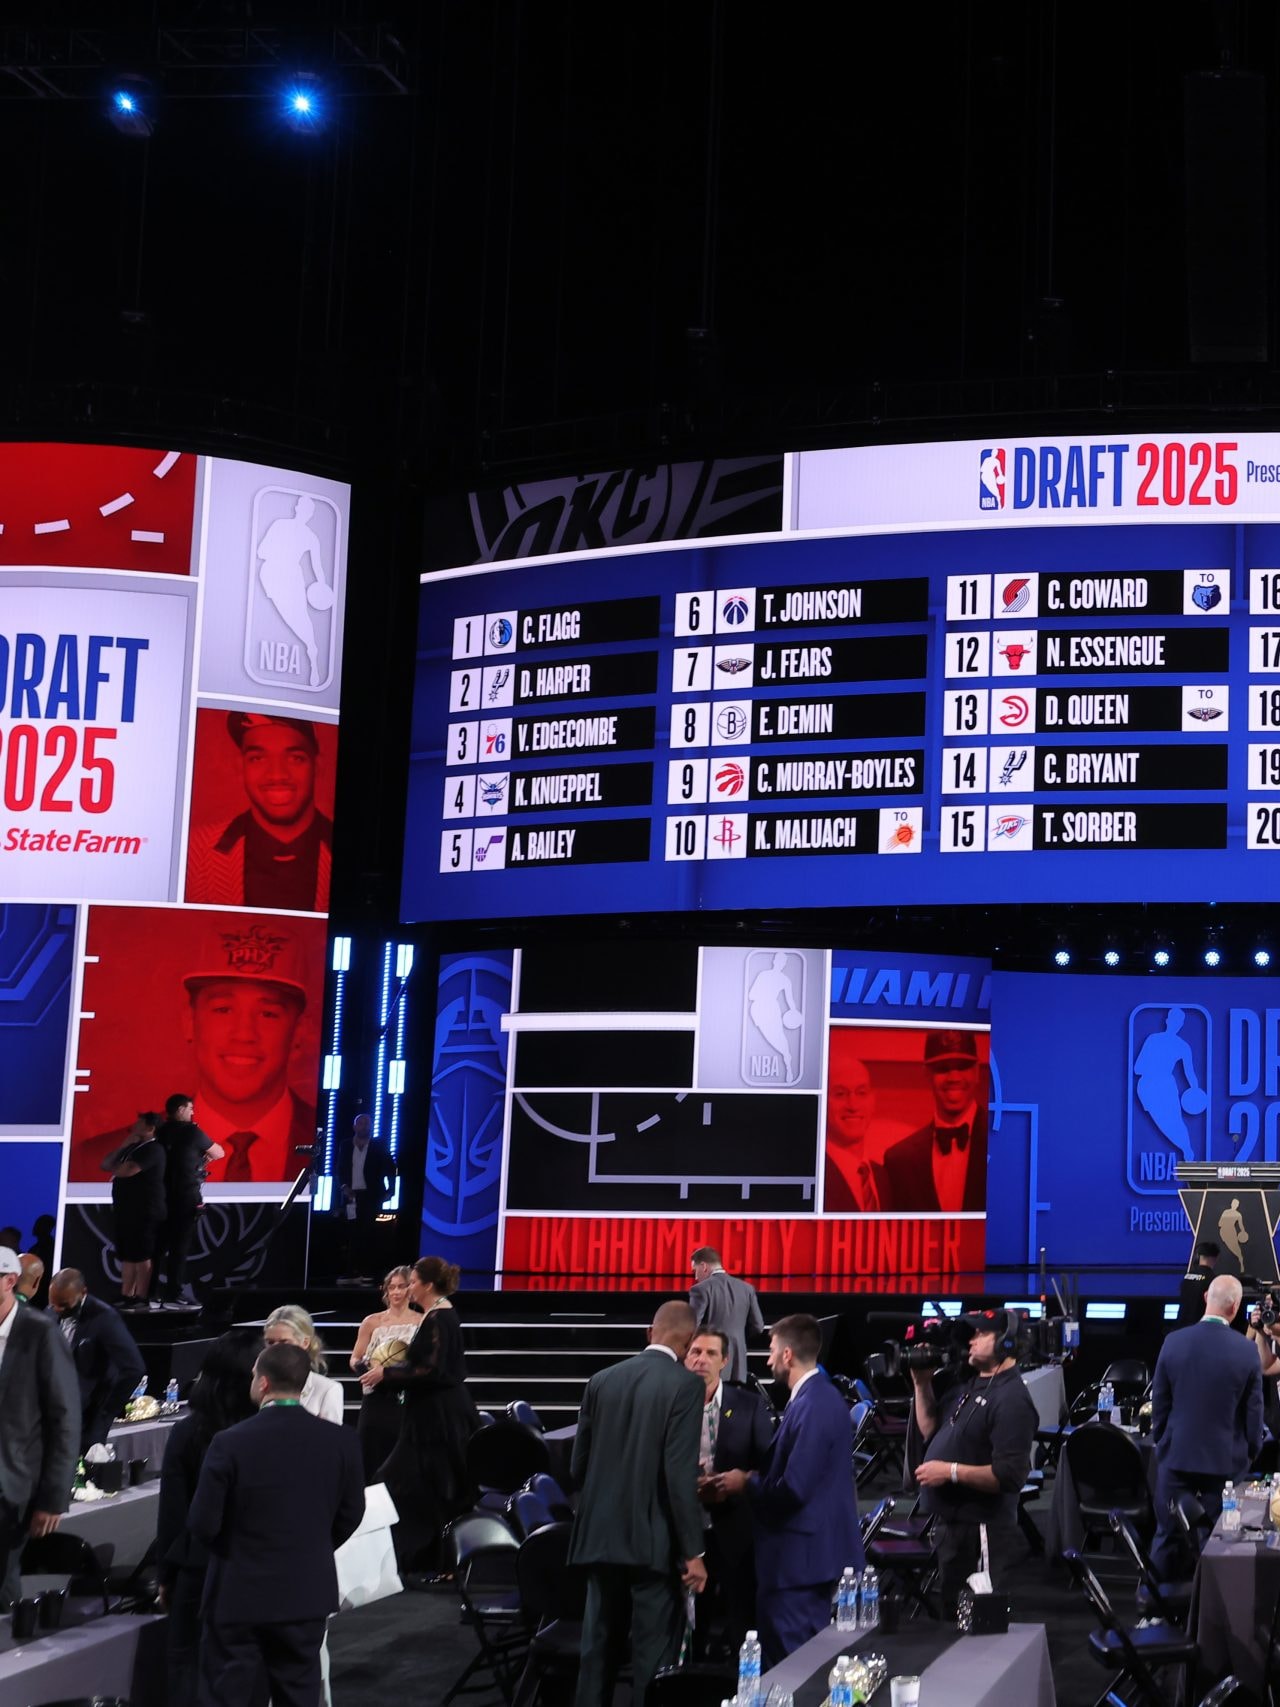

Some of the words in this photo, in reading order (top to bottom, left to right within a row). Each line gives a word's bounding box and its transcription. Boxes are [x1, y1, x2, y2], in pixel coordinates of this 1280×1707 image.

[1013, 444, 1129, 510] DRAFT
[1136, 442, 1239, 506] 2025
[981, 497, 996, 508] NBA
[688, 596, 701, 632] 6
[763, 593, 777, 623] T.
[779, 588, 862, 623] JOHNSON
[959, 579, 978, 616] 11
[1047, 579, 1065, 610] C.
[1069, 577, 1148, 610] COWARD
[1199, 573, 1215, 583] TO
[465, 621, 472, 654] 1
[522, 615, 536, 645] C.
[537, 610, 581, 643] FLAGG
[260, 640, 300, 675] NBA
[687, 652, 699, 687] 7
[760, 649, 777, 680] J.
[779, 646, 833, 679] FEARS
[956, 636, 979, 673] 12
[1046, 637, 1065, 667] N.
[1069, 635, 1166, 667] ESSENGUE
[459, 673, 471, 707] 2
[519, 669, 534, 698] D.
[535, 663, 591, 697] HARPER
[684, 707, 697, 743] 8
[759, 706, 774, 736] E.
[777, 703, 834, 735] DEMIN
[728, 711, 737, 735] B
[954, 694, 978, 731] 13
[1045, 695, 1063, 725] D.
[1067, 694, 1129, 725] QUEEN
[1197, 689, 1213, 699] TO
[457, 726, 468, 761] 3
[517, 723, 530, 752] V.
[531, 715, 618, 751] EDGECOMBE
[0, 724, 117, 814] 025
[681, 763, 694, 800] 9
[757, 763, 773, 793] C.
[775, 757, 916, 792] MURRAY-BOYLES
[953, 752, 977, 789] 14
[1043, 753, 1062, 785] C.
[1065, 752, 1140, 784] BRYANT
[454, 780, 464, 814] 4
[514, 777, 529, 807] K.
[530, 772, 603, 806] KNUEPPEL
[451, 833, 462, 868] 5
[511, 832, 525, 861] A.
[527, 829, 577, 861] BAILEY
[675, 819, 697, 856] 10
[754, 820, 771, 850] K.
[774, 817, 857, 850] MALUACH
[894, 811, 908, 821] TO
[951, 810, 975, 847] 15
[1042, 811, 1058, 843] T.
[1061, 811, 1137, 843] SORBER
[751, 1055, 780, 1078] NBA
[1140, 1151, 1178, 1182] NBA
[723, 1218, 798, 1275] CITY
[816, 1218, 961, 1275] THUNDER
